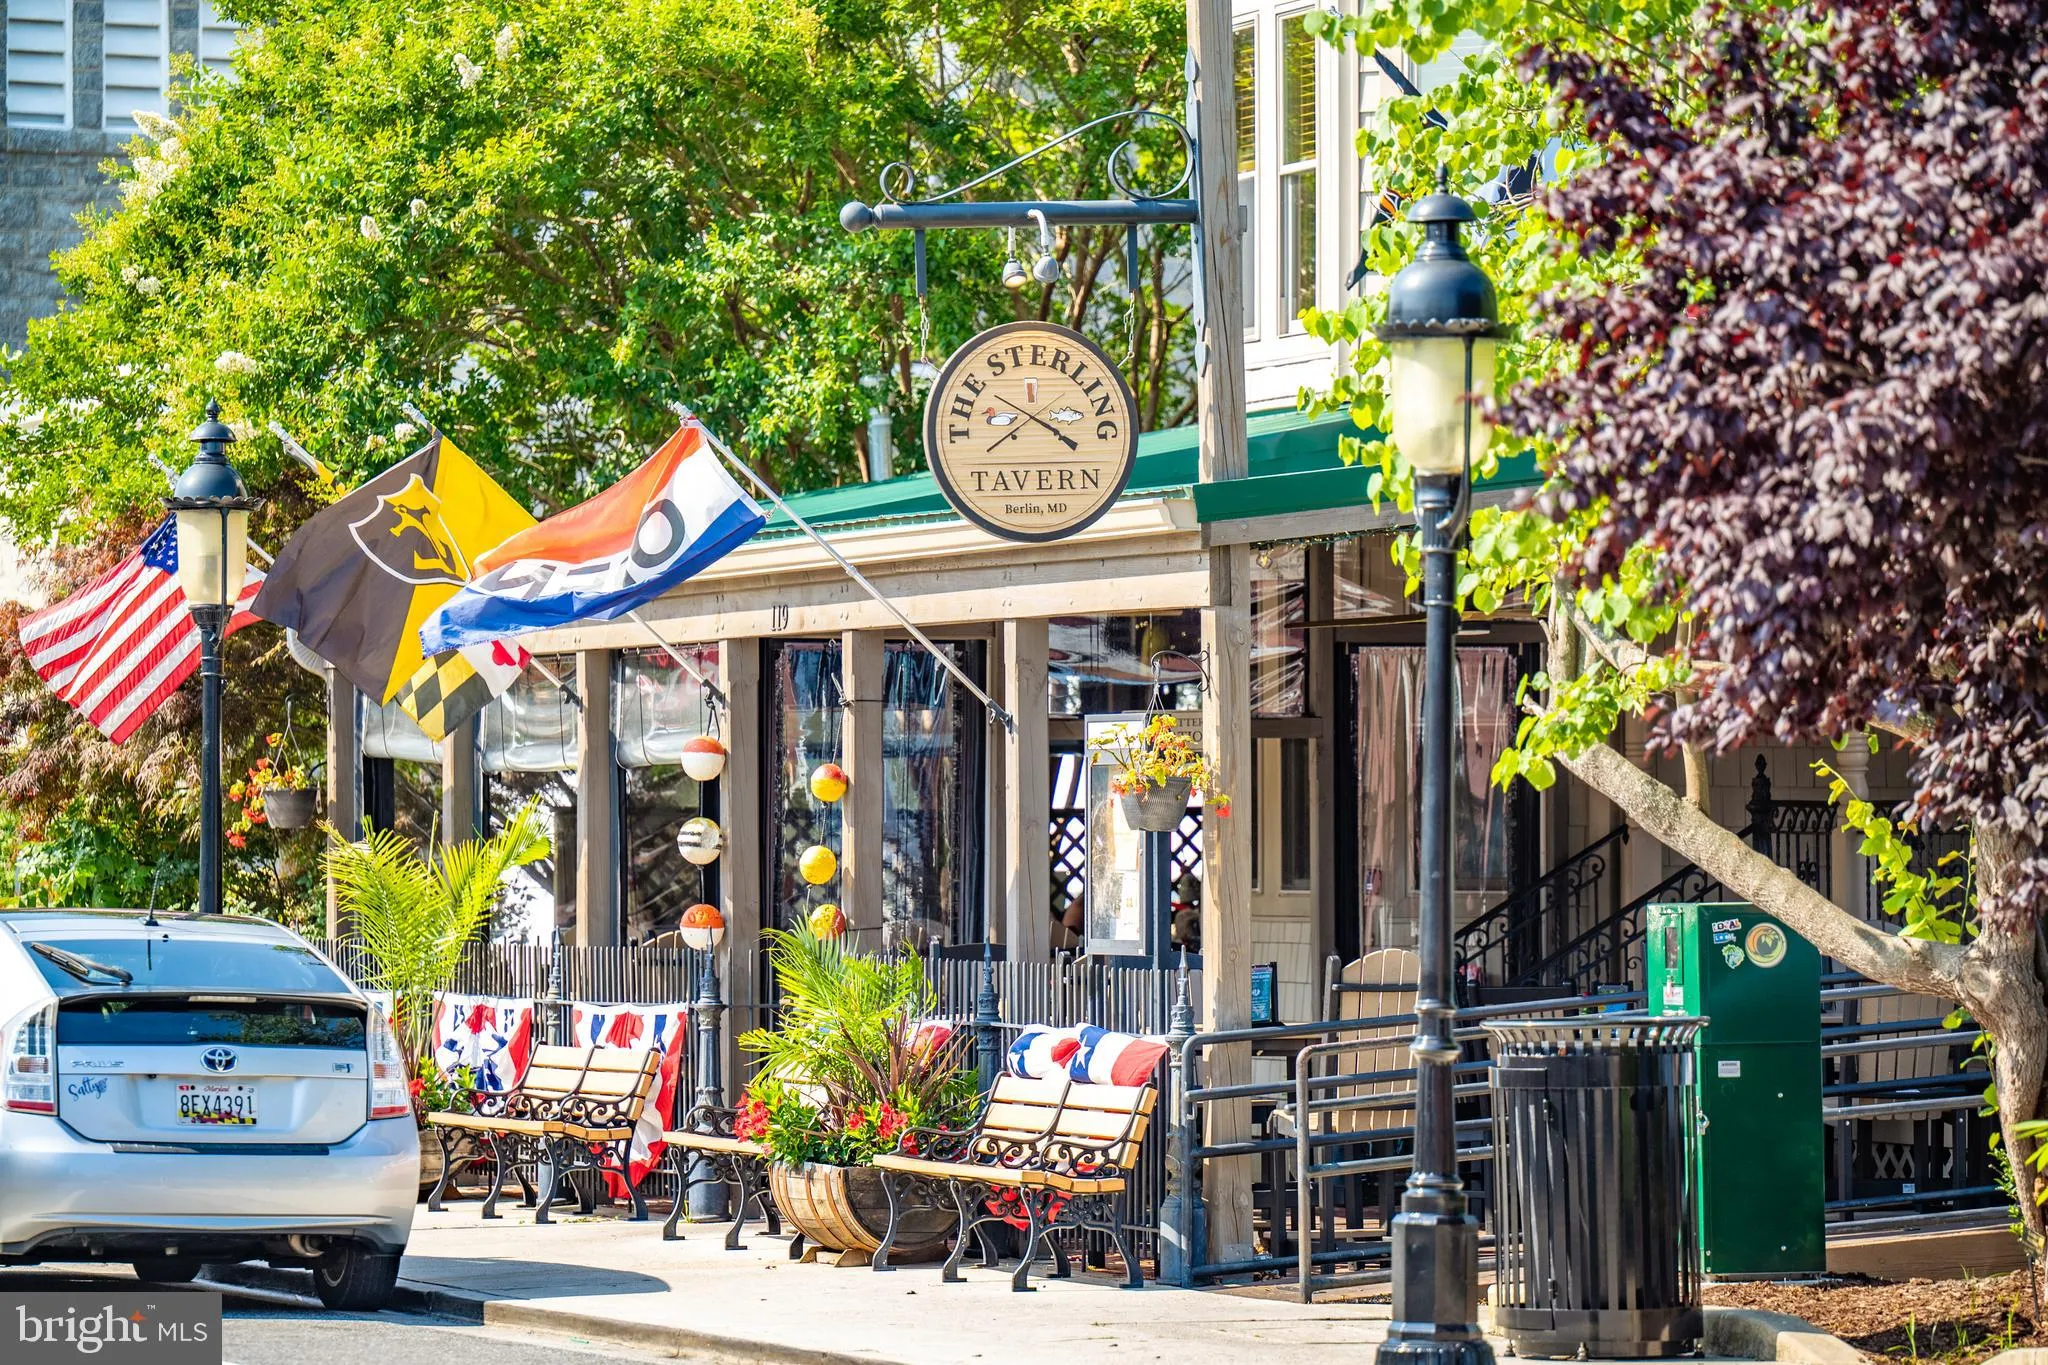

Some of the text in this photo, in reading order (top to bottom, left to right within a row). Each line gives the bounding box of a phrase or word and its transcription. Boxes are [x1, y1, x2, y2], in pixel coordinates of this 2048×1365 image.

[950, 344, 1118, 444] THE STERLING
[970, 468, 1101, 492] TAVERN
[1004, 503, 1067, 515] Berlin, MD
[771, 604, 789, 632] 119
[180, 1094, 252, 1118] 8EX4391
